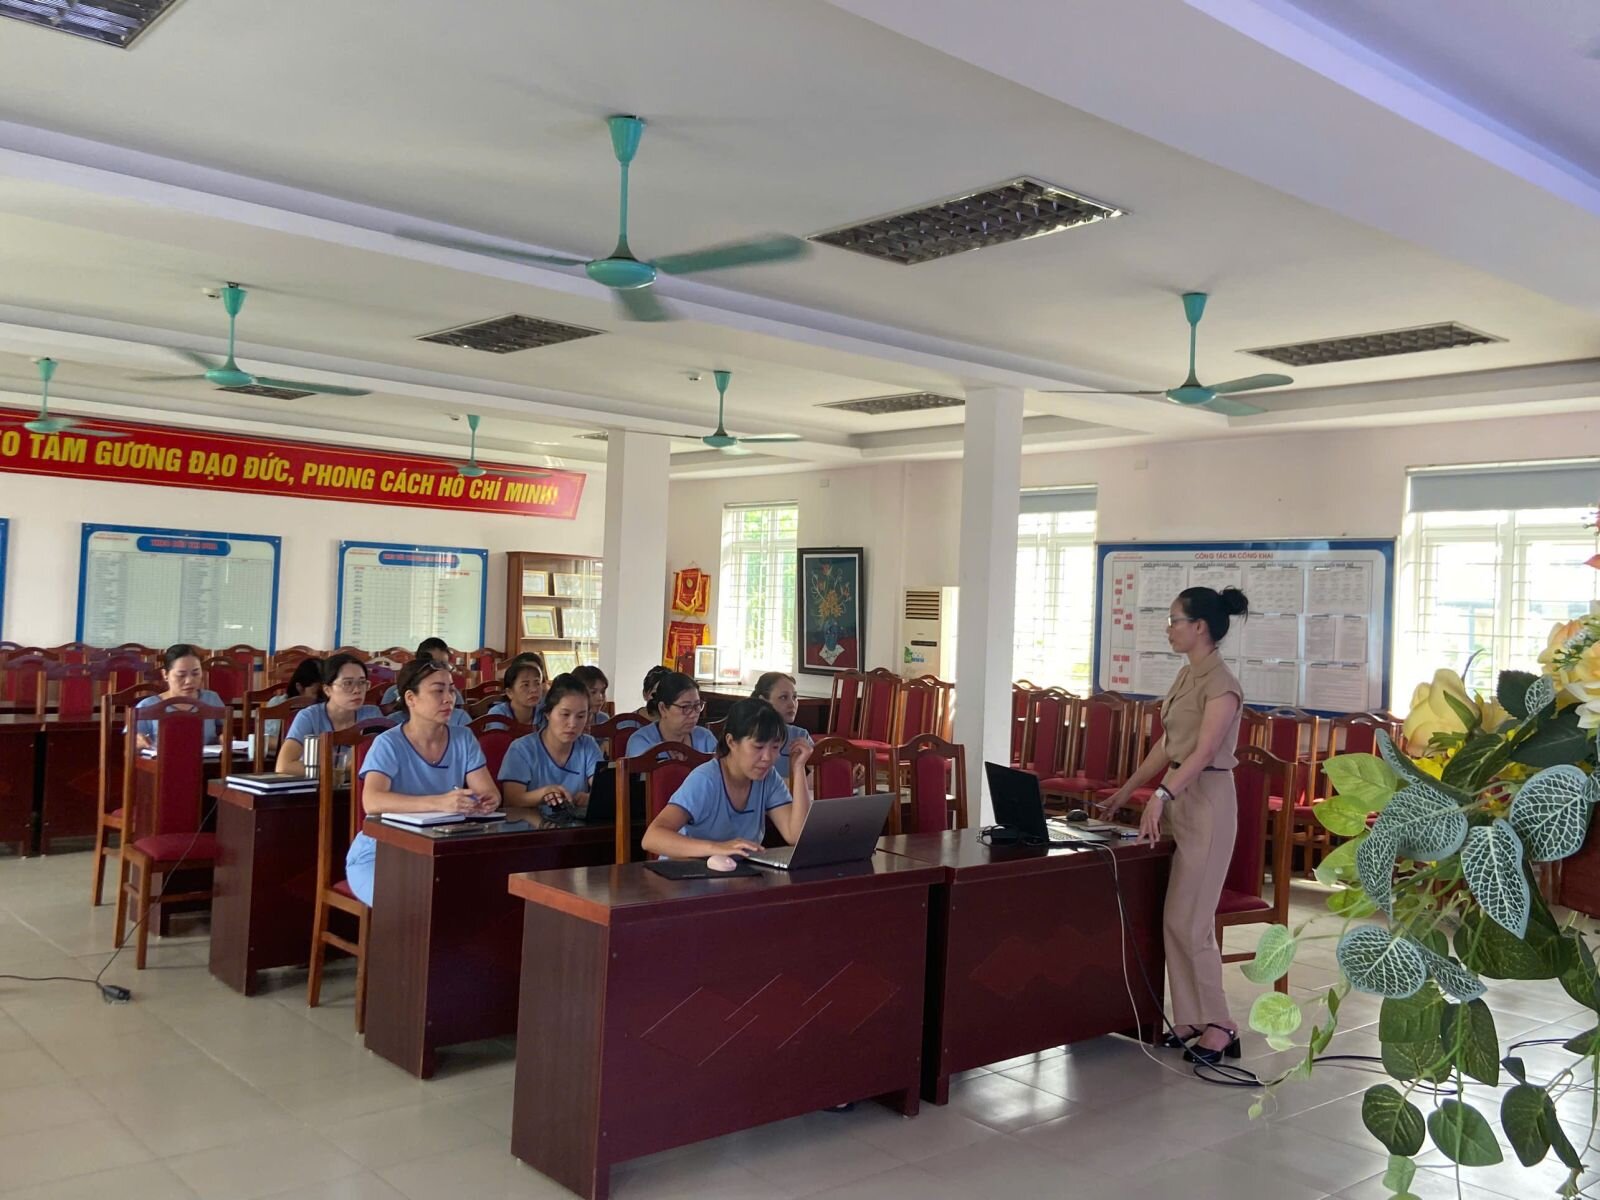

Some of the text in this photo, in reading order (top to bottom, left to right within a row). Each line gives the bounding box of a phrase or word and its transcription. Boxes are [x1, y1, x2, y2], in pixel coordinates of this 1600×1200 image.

[0, 430, 20, 456] O
[94, 441, 182, 472] GƯƠNG
[189, 451, 237, 480] ĐẠO
[243, 452, 294, 485] ĐỨC,
[302, 463, 376, 490] PHONG
[380, 468, 435, 495] CÁCH
[469, 477, 503, 501] CHÍ
